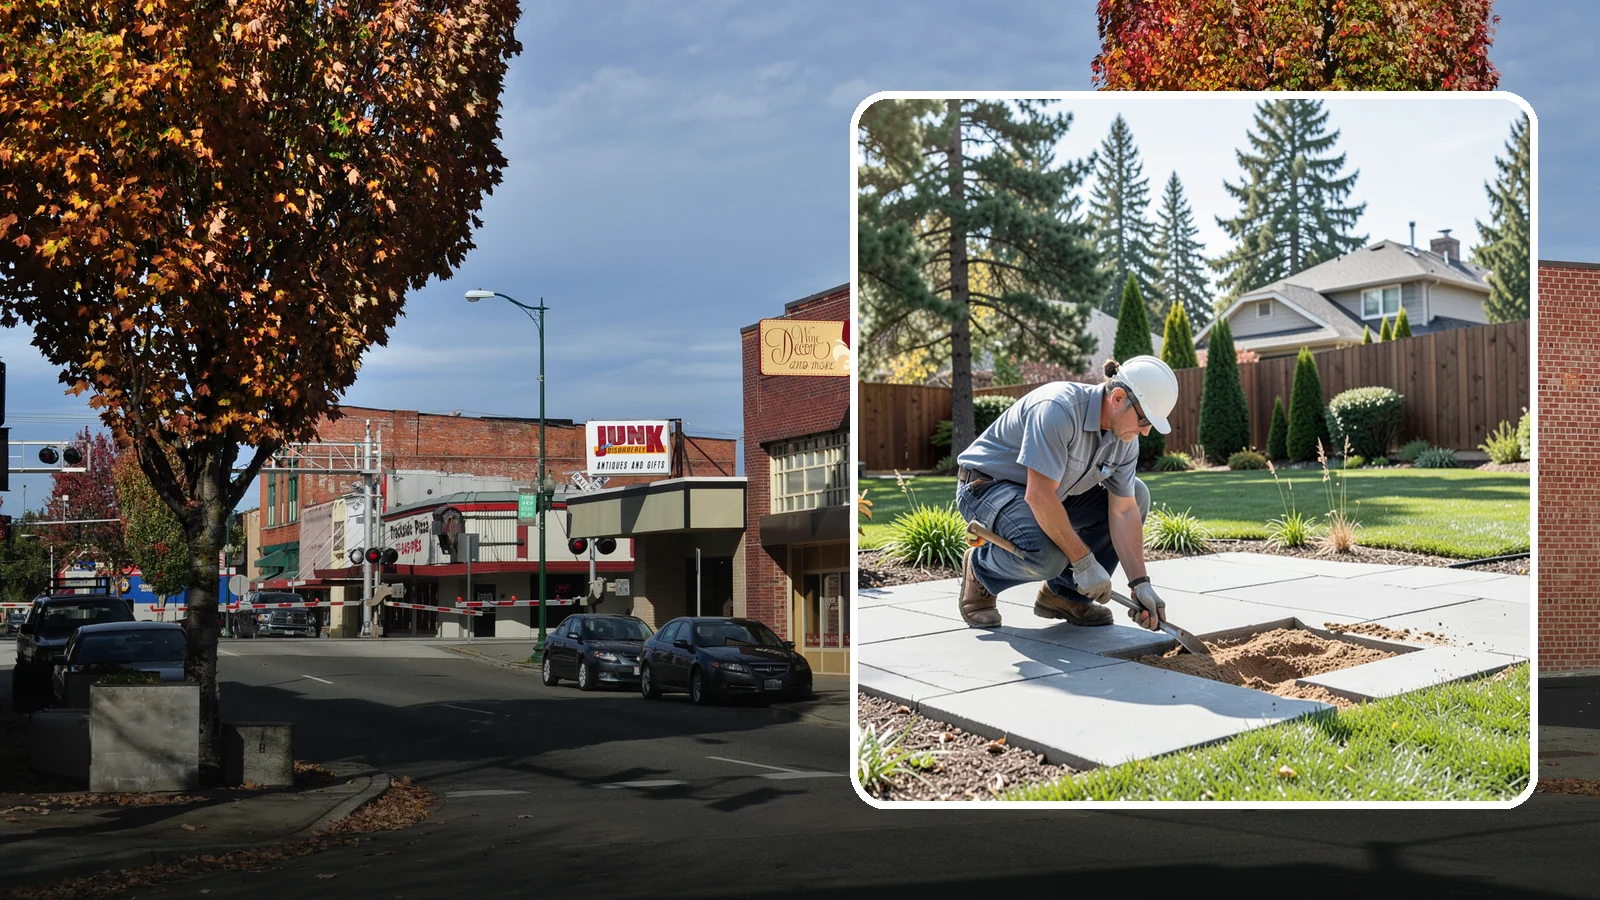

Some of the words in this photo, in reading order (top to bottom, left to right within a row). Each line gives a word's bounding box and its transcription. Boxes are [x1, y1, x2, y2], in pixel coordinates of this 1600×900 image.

[595, 425, 665, 457] JUNK
[607, 446, 646, 454] DISORDERLY
[597, 461, 628, 470] ANTIQUES
[631, 461, 643, 470] AND
[647, 460, 665, 469] GIFTS
[390, 521, 413, 540] Trackside
[414, 519, 429, 535] Pizza
